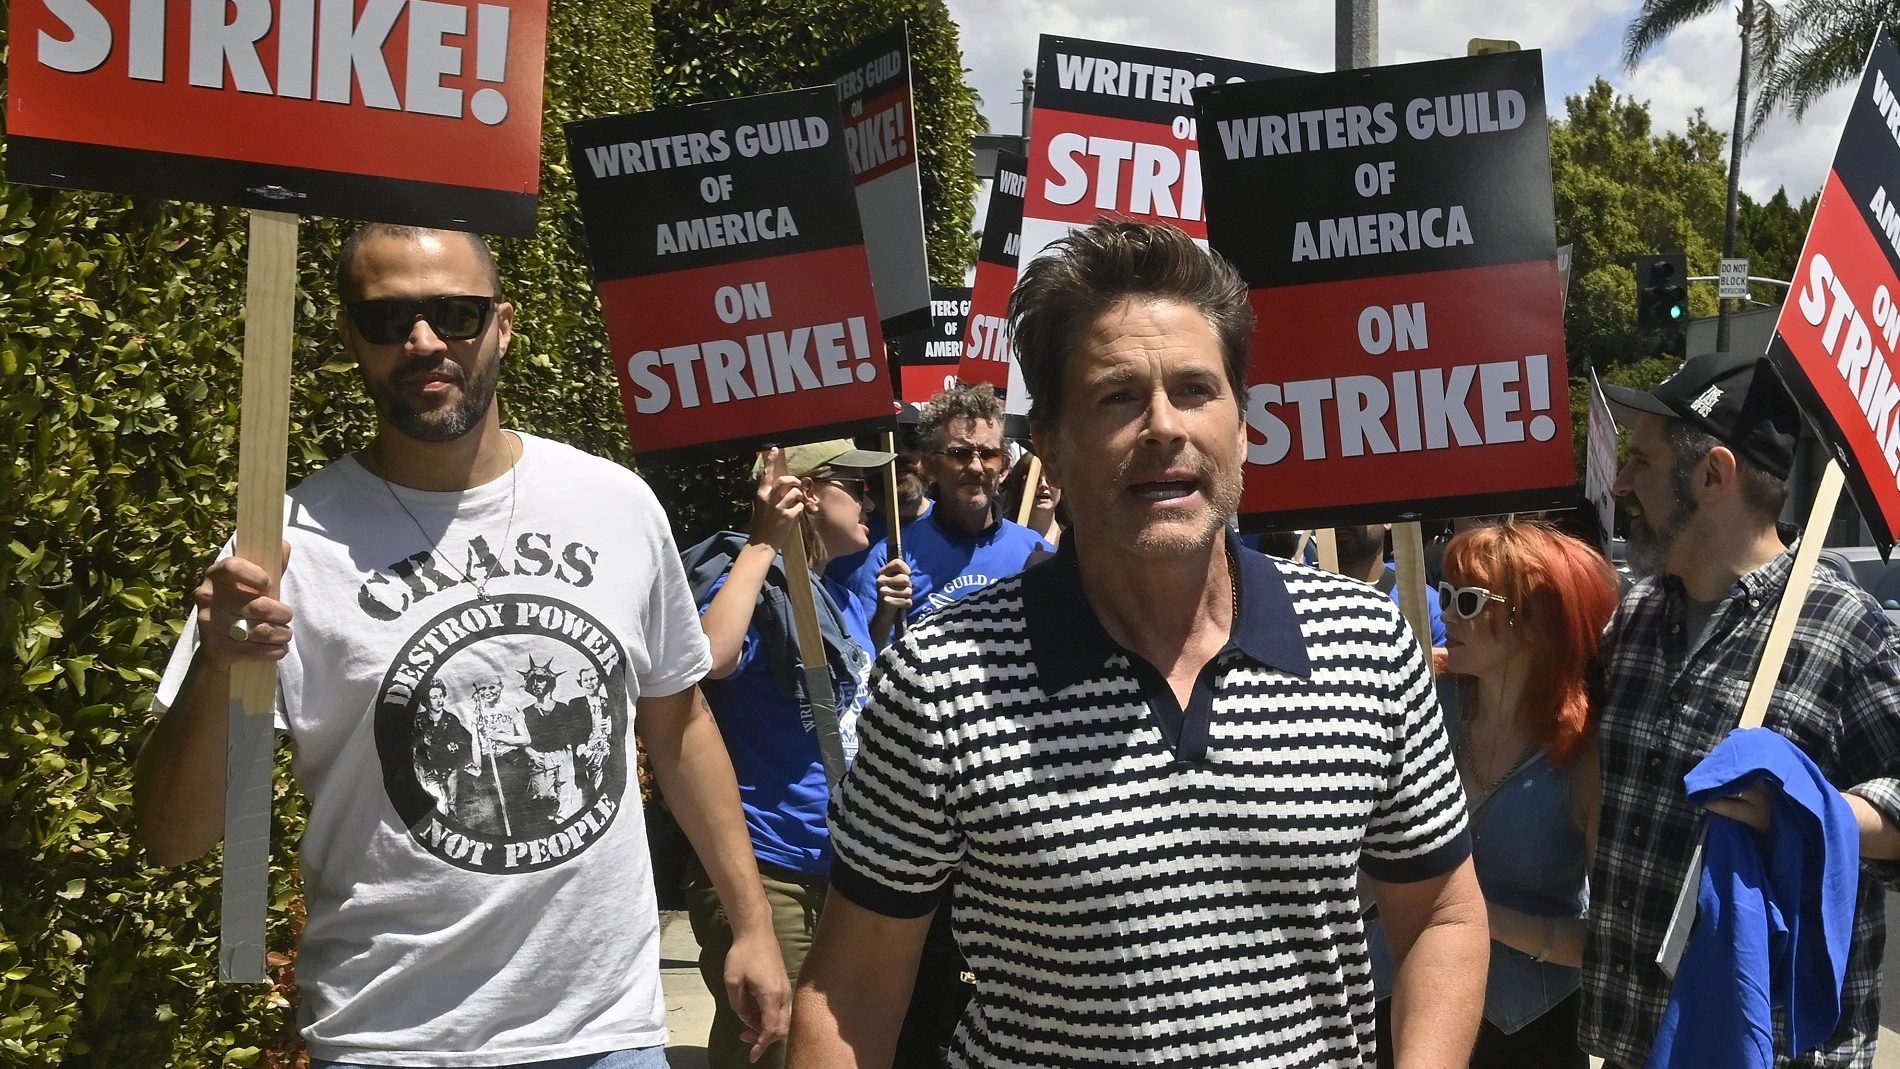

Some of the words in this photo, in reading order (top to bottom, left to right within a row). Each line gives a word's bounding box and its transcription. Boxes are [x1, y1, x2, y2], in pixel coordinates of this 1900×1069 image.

[37, 0, 511, 126] STRIKE!
[866, 49, 902, 88] GUILD
[585, 129, 731, 179] WRITERS
[735, 116, 829, 159] GUILD
[1216, 102, 1397, 160] WRITERS
[1406, 89, 1525, 141] GUILD
[700, 174, 733, 203] OF
[1044, 132, 1207, 222] STRI
[1355, 162, 1396, 198] OF
[656, 206, 799, 256] AMERICA
[1292, 205, 1474, 263] AMERICA
[1720, 276, 1746, 286] BLOCK
[1721, 263, 1731, 273] DO
[1732, 263, 1747, 273] NOT
[714, 281, 772, 324] ON
[944, 322, 958, 335] OF
[1357, 302, 1429, 355] ON
[627, 316, 877, 414] STRIKE!
[1246, 354, 1557, 466] STRIKE!
[357, 532, 599, 622] CRASS
[944, 574, 987, 594] GUILD
[383, 603, 504, 707] DESTROY
[516, 602, 621, 675] POWER
[419, 817, 493, 866] NOT
[503, 793, 617, 868] PEOPLE
